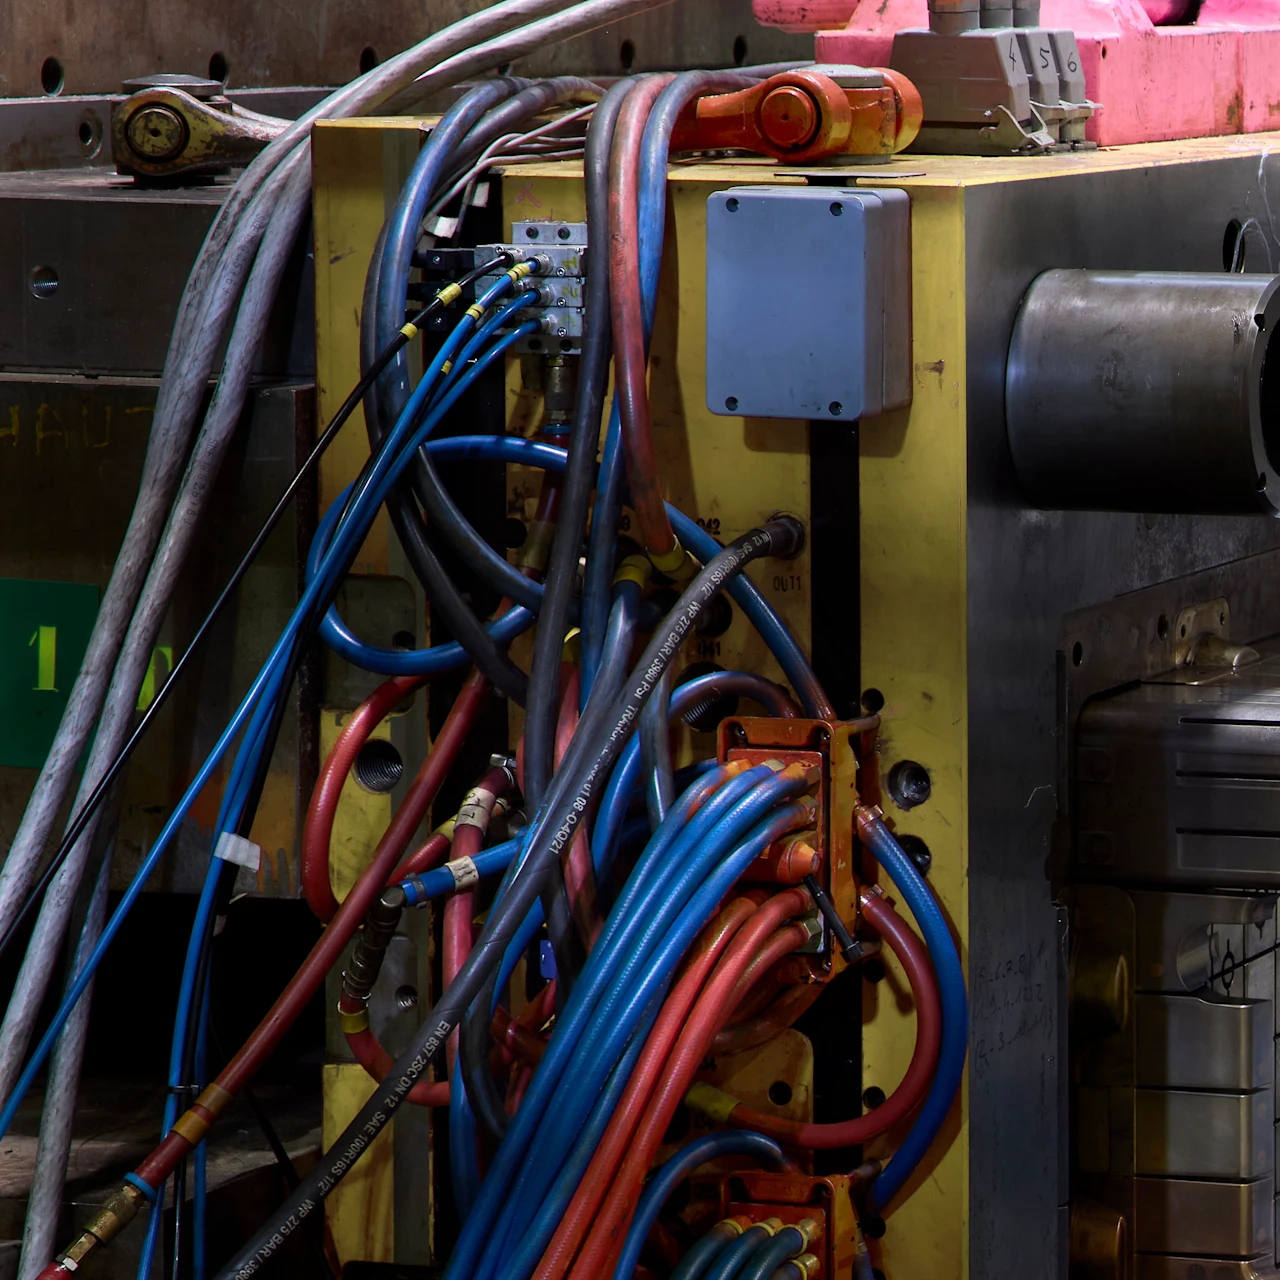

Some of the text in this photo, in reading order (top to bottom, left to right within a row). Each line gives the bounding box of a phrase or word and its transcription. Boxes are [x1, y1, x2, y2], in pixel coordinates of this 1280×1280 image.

[1008, 38, 1017, 72] 4
[1039, 47, 1050, 69] 5
[1067, 52, 1078, 73] 6
[733, 541, 754, 560] SAE
[710, 554, 741, 586] 100R16S
[773, 575, 801, 593] OUT1
[686, 600, 702, 618] WP
[675, 614, 692, 636] 275
[661, 631, 681, 657] BAR
[644, 657, 666, 686] 3980
[633, 680, 651, 700] PSI
[572, 796, 587, 812] 08
[432, 1020, 451, 1041] EN
[422, 1036, 440, 1058] 857
[411, 1056, 428, 1079] 2SC
[394, 1075, 412, 1095] DN
[383, 1094, 399, 1108] 12
[363, 1111, 386, 1135] SAE
[331, 1134, 368, 1176] 100R16S
[317, 1175, 335, 1197] 1/2"
[298, 1198, 316, 1219] WP
[280, 1215, 300, 1237] 275
[259, 1233, 285, 1259] BAR
